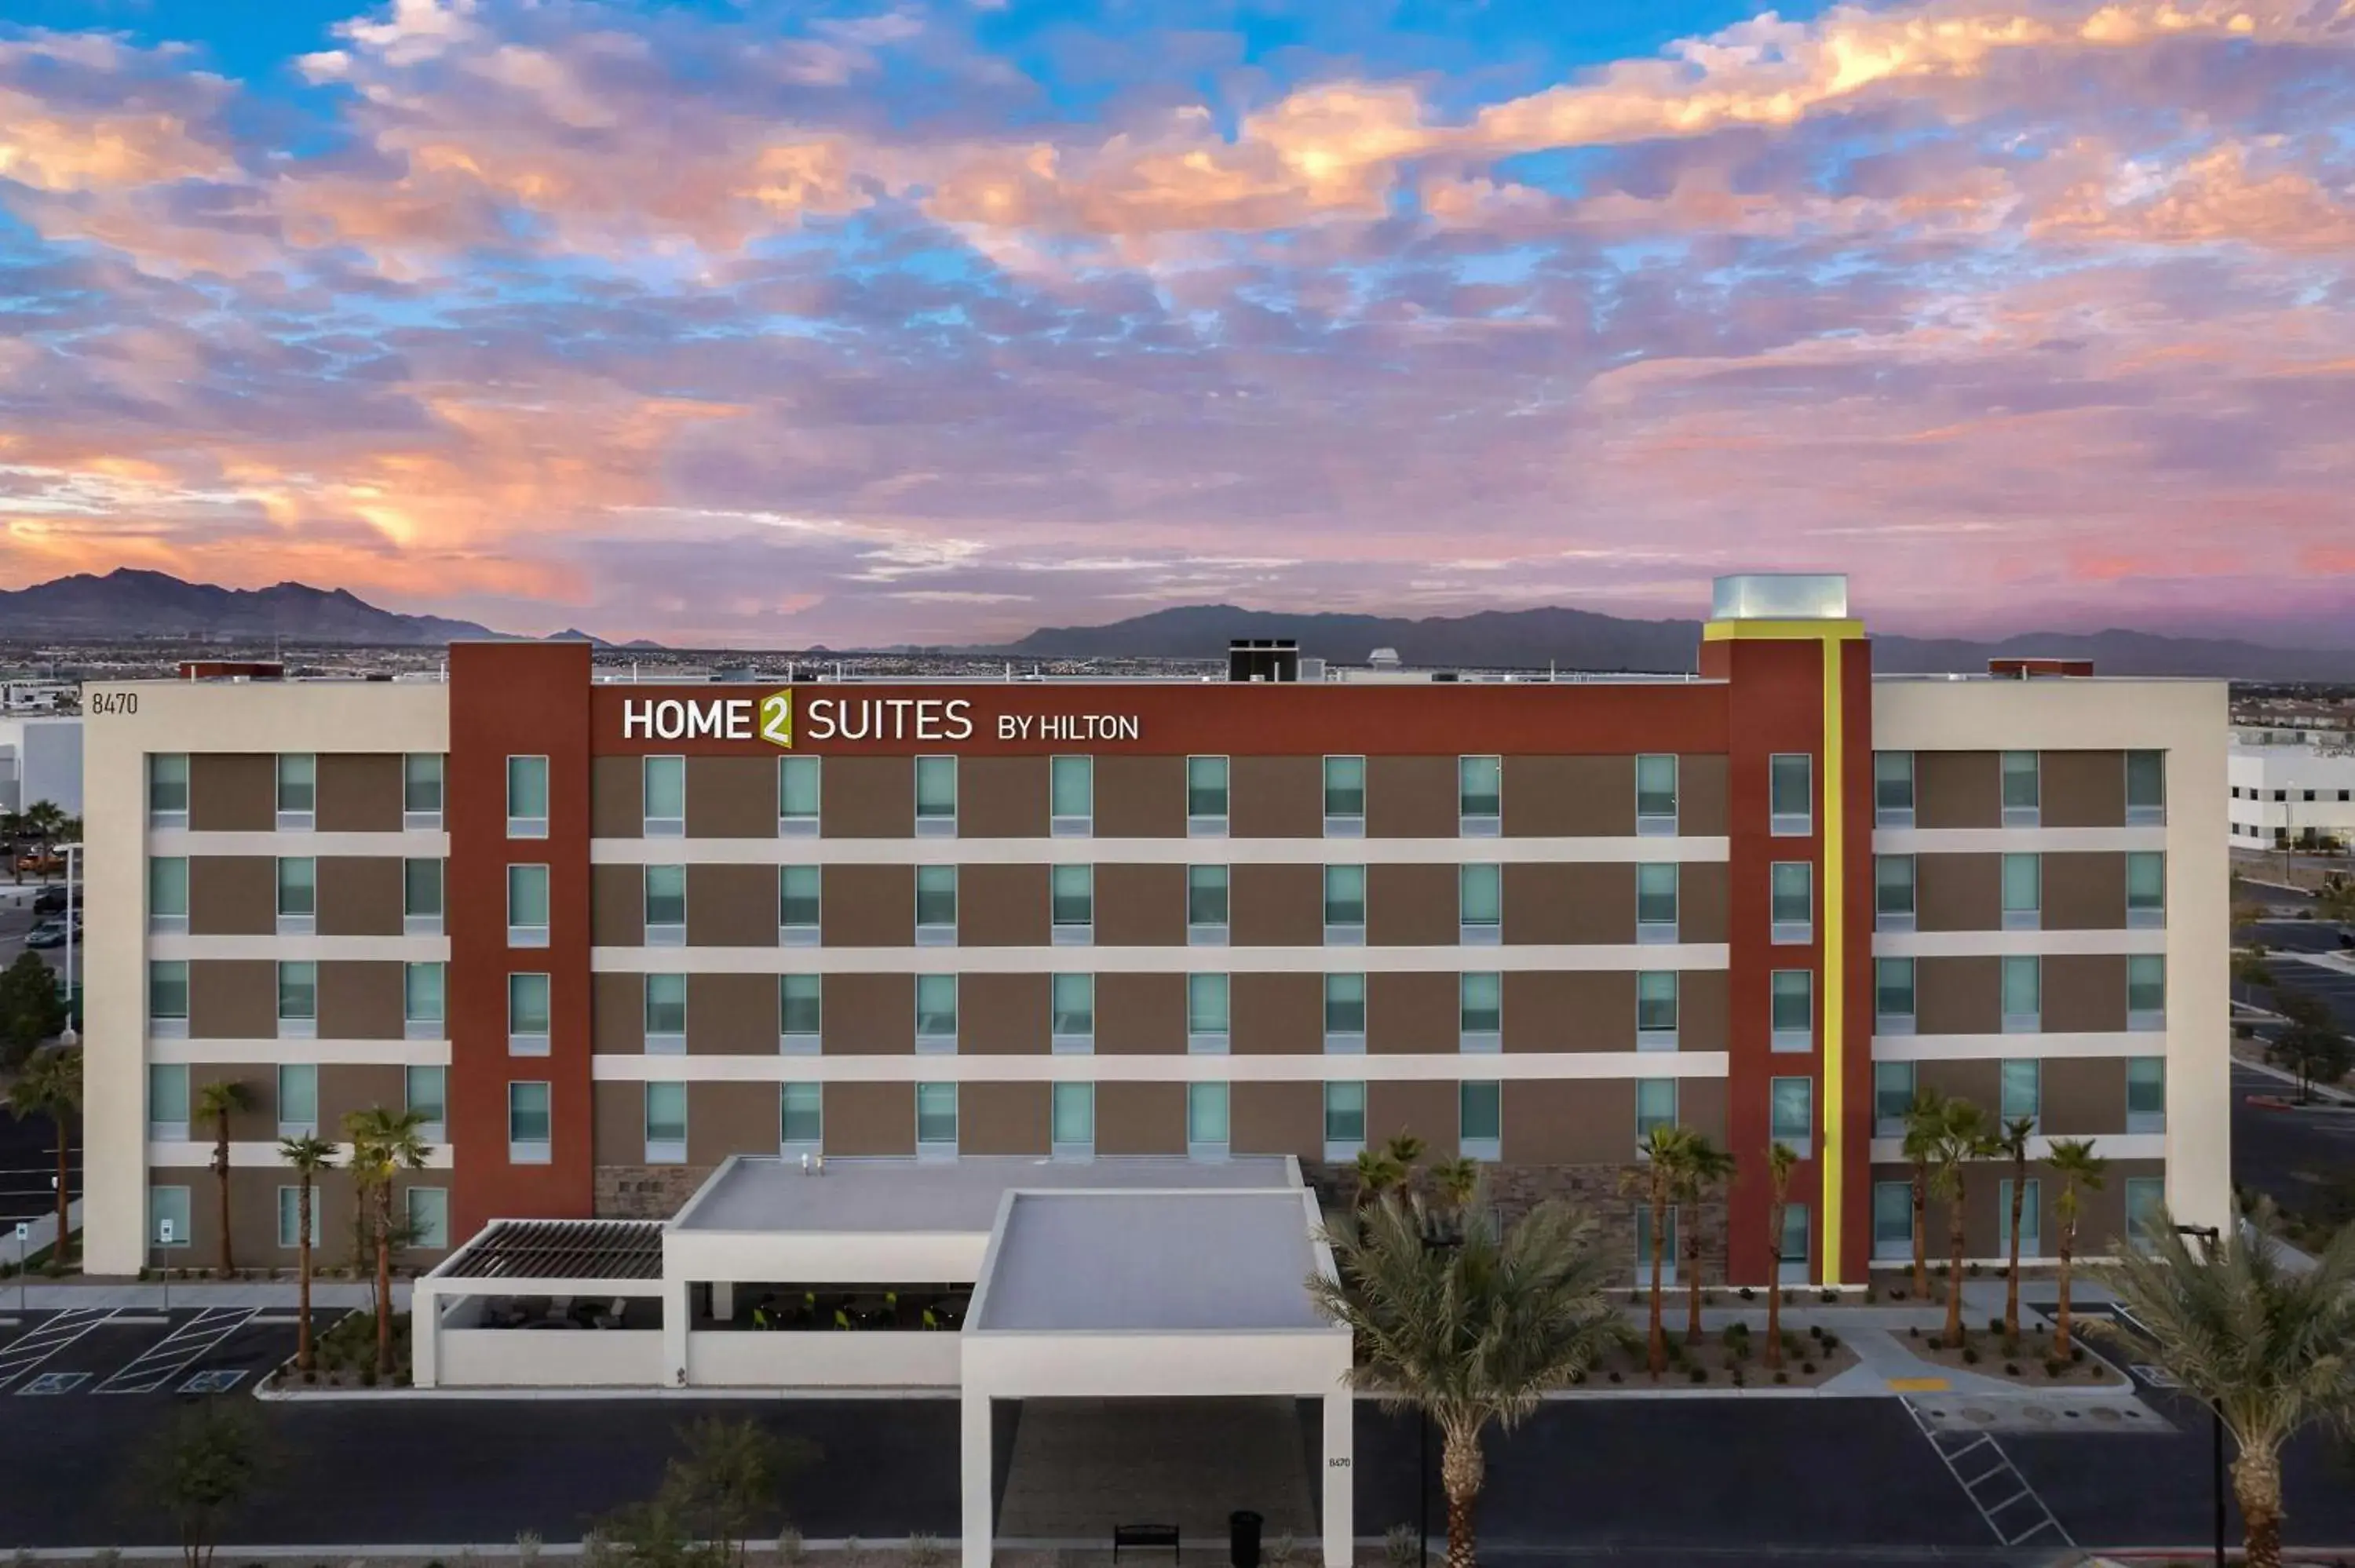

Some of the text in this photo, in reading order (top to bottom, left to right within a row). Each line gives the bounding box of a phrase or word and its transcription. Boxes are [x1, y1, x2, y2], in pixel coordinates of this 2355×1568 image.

[92, 692, 138, 715] 8470
[624, 695, 1138, 744] HOME 2 SUITES BY HILTON
